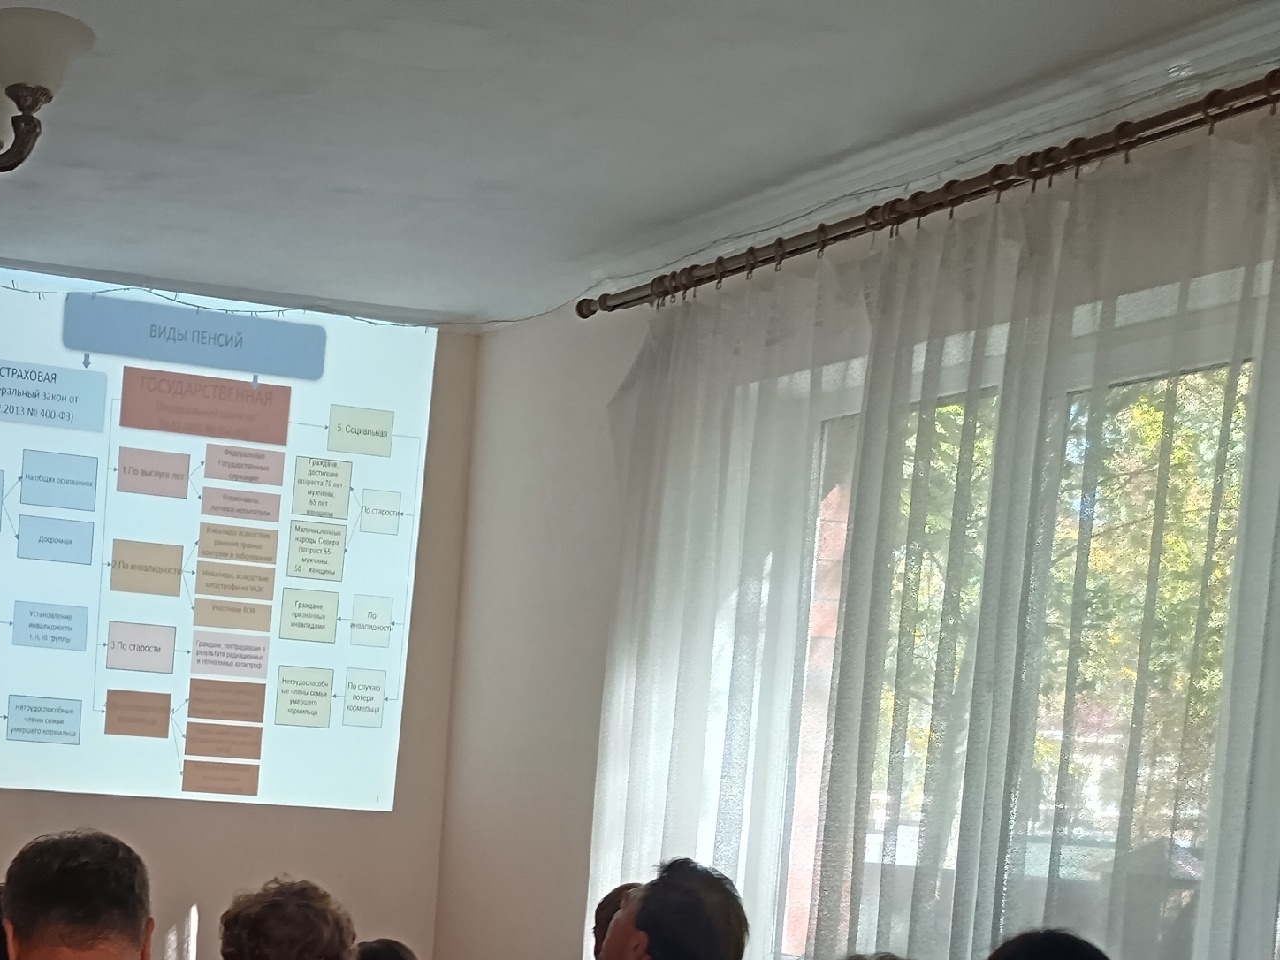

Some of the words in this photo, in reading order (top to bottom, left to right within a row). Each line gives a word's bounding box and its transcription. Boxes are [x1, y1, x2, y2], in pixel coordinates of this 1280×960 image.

[149, 324, 188, 342] ВИДЫ
[191, 326, 243, 349] ПЕНСИЙ
[0, 366, 57, 384] СТРАХОВАЯ
[140, 376, 273, 405] ГОСУДАРСТВЕННАЯ
[367, 611, 377, 620] По
[347, 681, 357, 690] По
